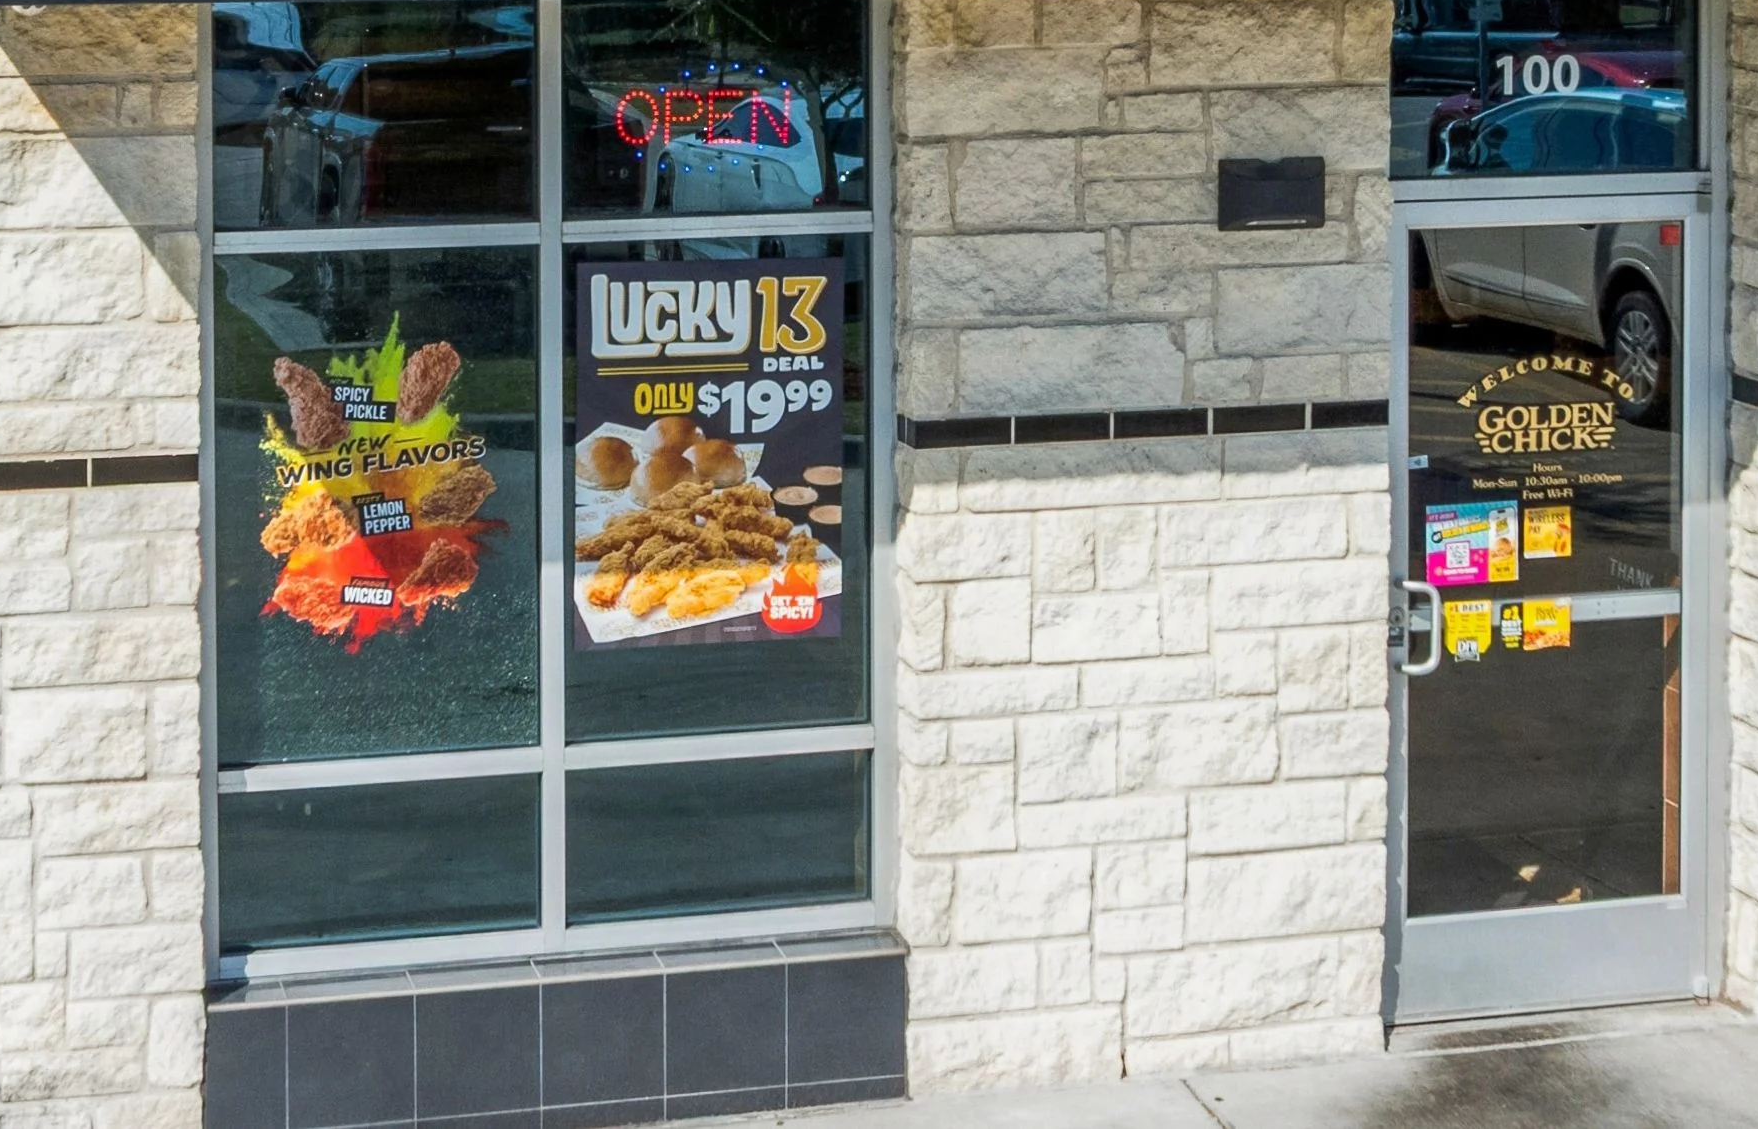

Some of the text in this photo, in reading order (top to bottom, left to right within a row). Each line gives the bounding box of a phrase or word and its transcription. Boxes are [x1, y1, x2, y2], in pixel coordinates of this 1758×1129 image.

[1495, 54, 1581, 96] 100
[615, 88, 791, 146] OPEN
[590, 273, 828, 359] LUCKY 13
[763, 355, 825, 372] DEAL
[1457, 355, 1634, 408] WELCOME TO
[334, 386, 370, 402] SPICY
[345, 403, 388, 420] PICKLE
[1478, 402, 1615, 434] GOLDEN
[338, 433, 392, 456] NEW
[1491, 427, 1599, 453] CHICK
[276, 437, 487, 488] WING FLAVORS
[1532, 463, 1563, 472] Hours
[1473, 477, 1518, 489] Mon-Sun
[1522, 488, 1573, 500] Free Wi-Fi
[363, 500, 403, 519] LEMON
[365, 515, 411, 534] PEPPER
[344, 586, 393, 605] WICKED
[770, 606, 814, 620] SPICY!
